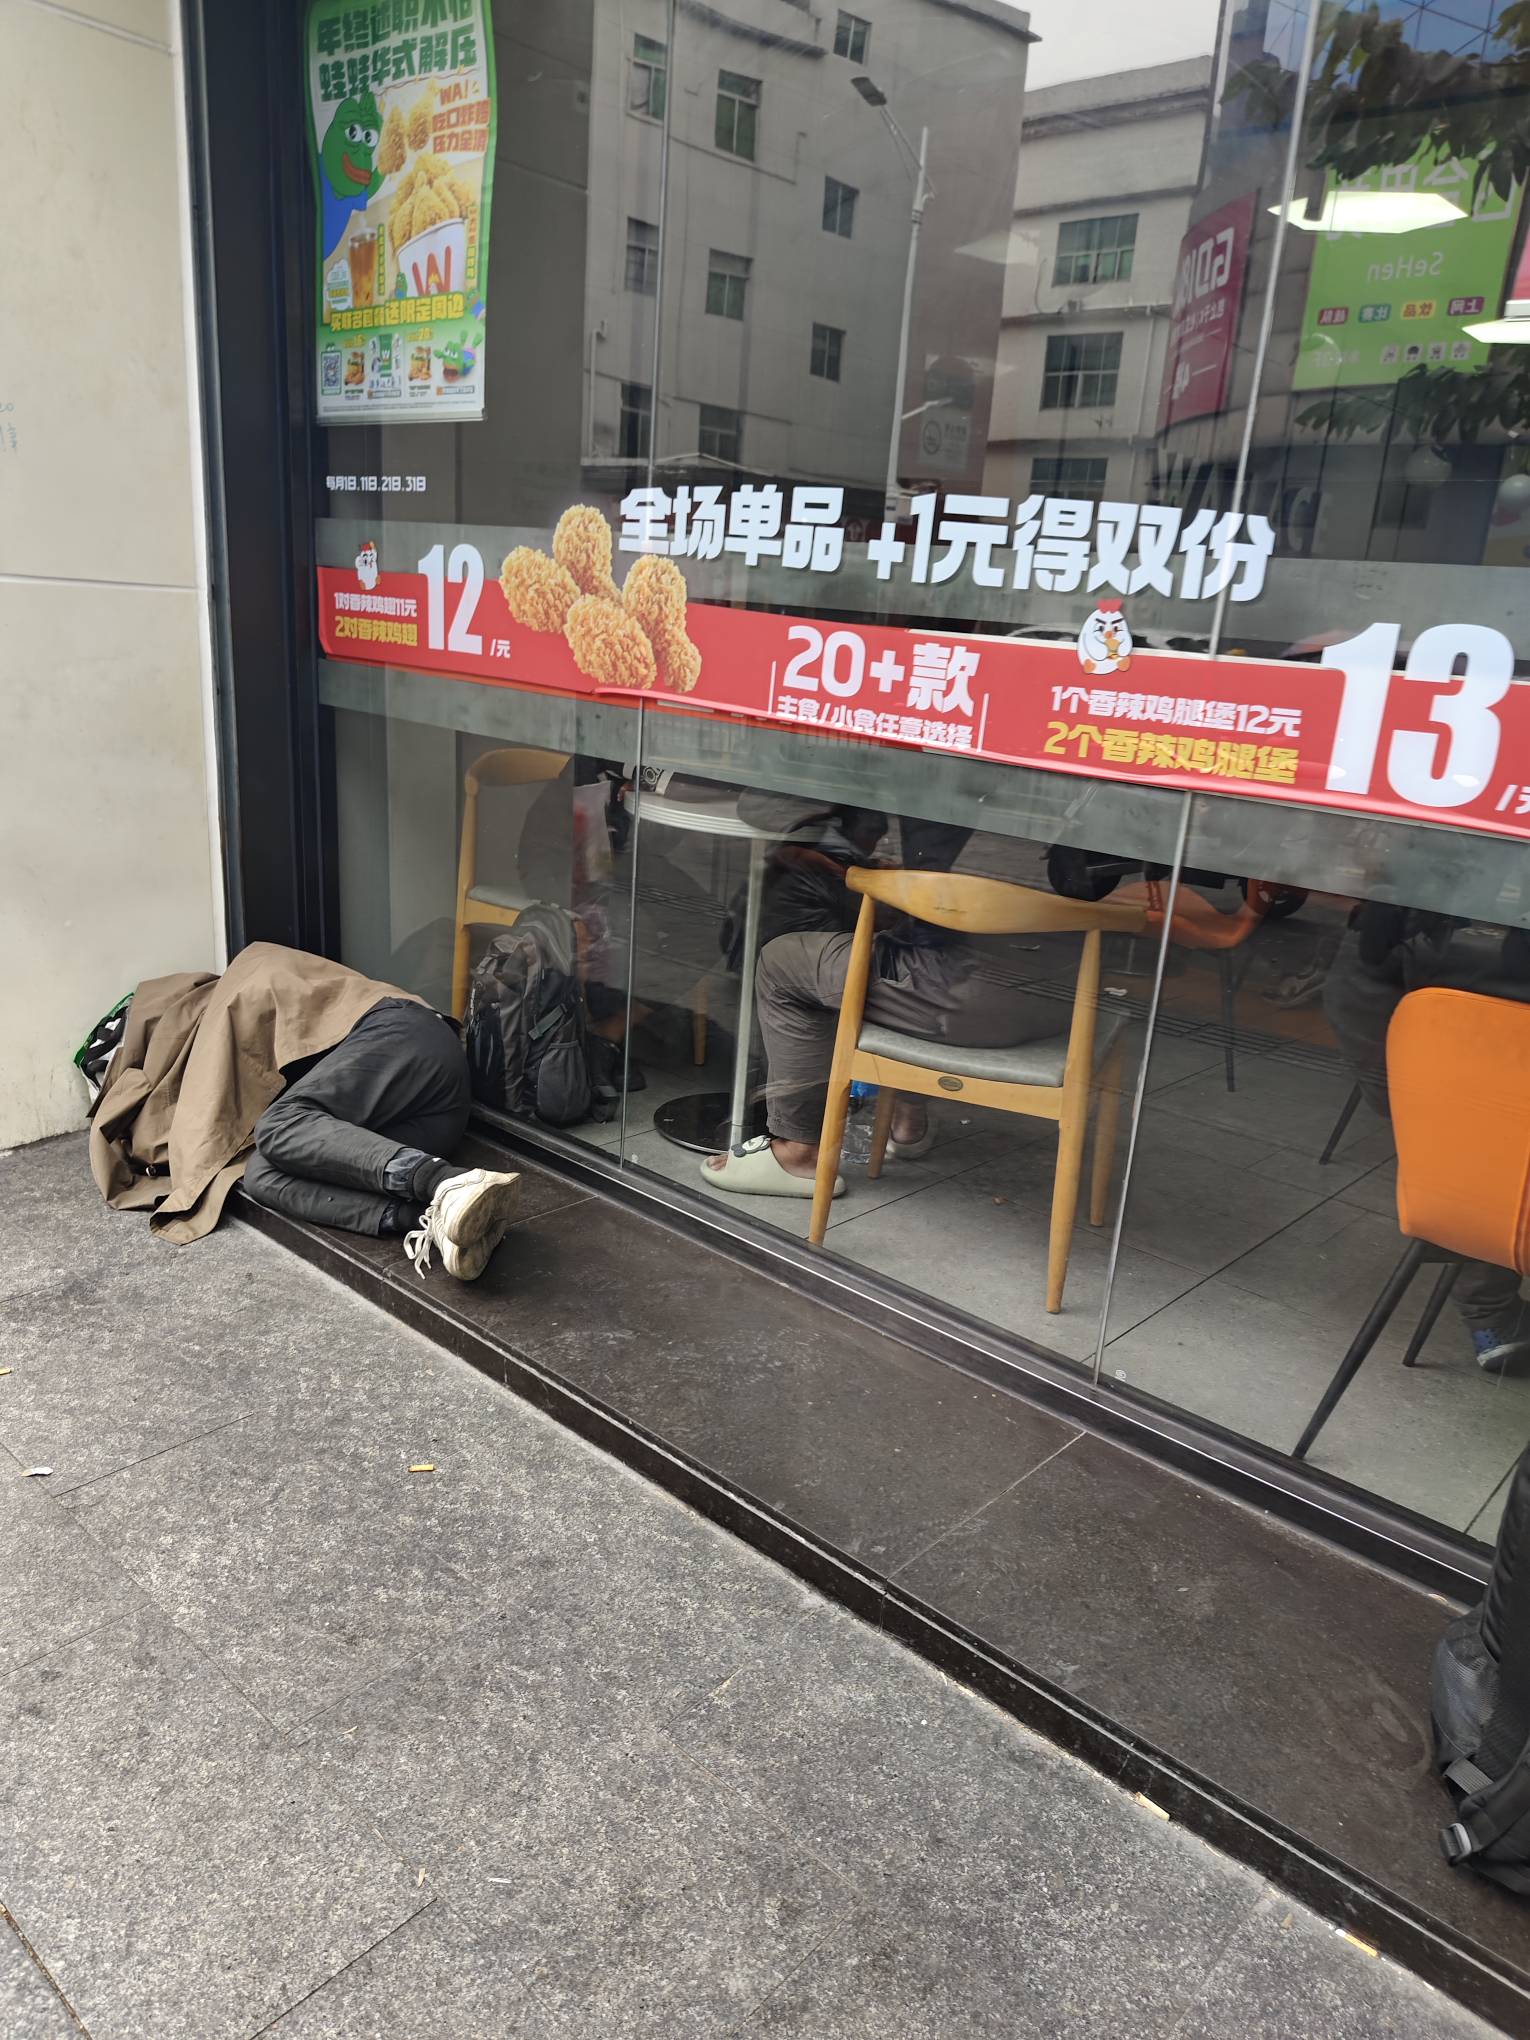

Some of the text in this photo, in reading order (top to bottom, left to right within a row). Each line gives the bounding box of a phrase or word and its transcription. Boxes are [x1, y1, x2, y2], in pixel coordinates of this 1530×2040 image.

[618, 485, 1276, 602] 全场单品 +1元得双份
[335, 615, 417, 647] 2对香辣鸡翅
[418, 543, 511, 659] 12 /元
[782, 625, 981, 718] 20+款
[776, 695, 973, 751] 主食/小食任意选择
[1051, 685, 1303, 738] 1个香辣鸡腿堡12元
[1320, 622, 1515, 808] 13
[1044, 721, 1300, 785] 2个香辣鸡腿堡
